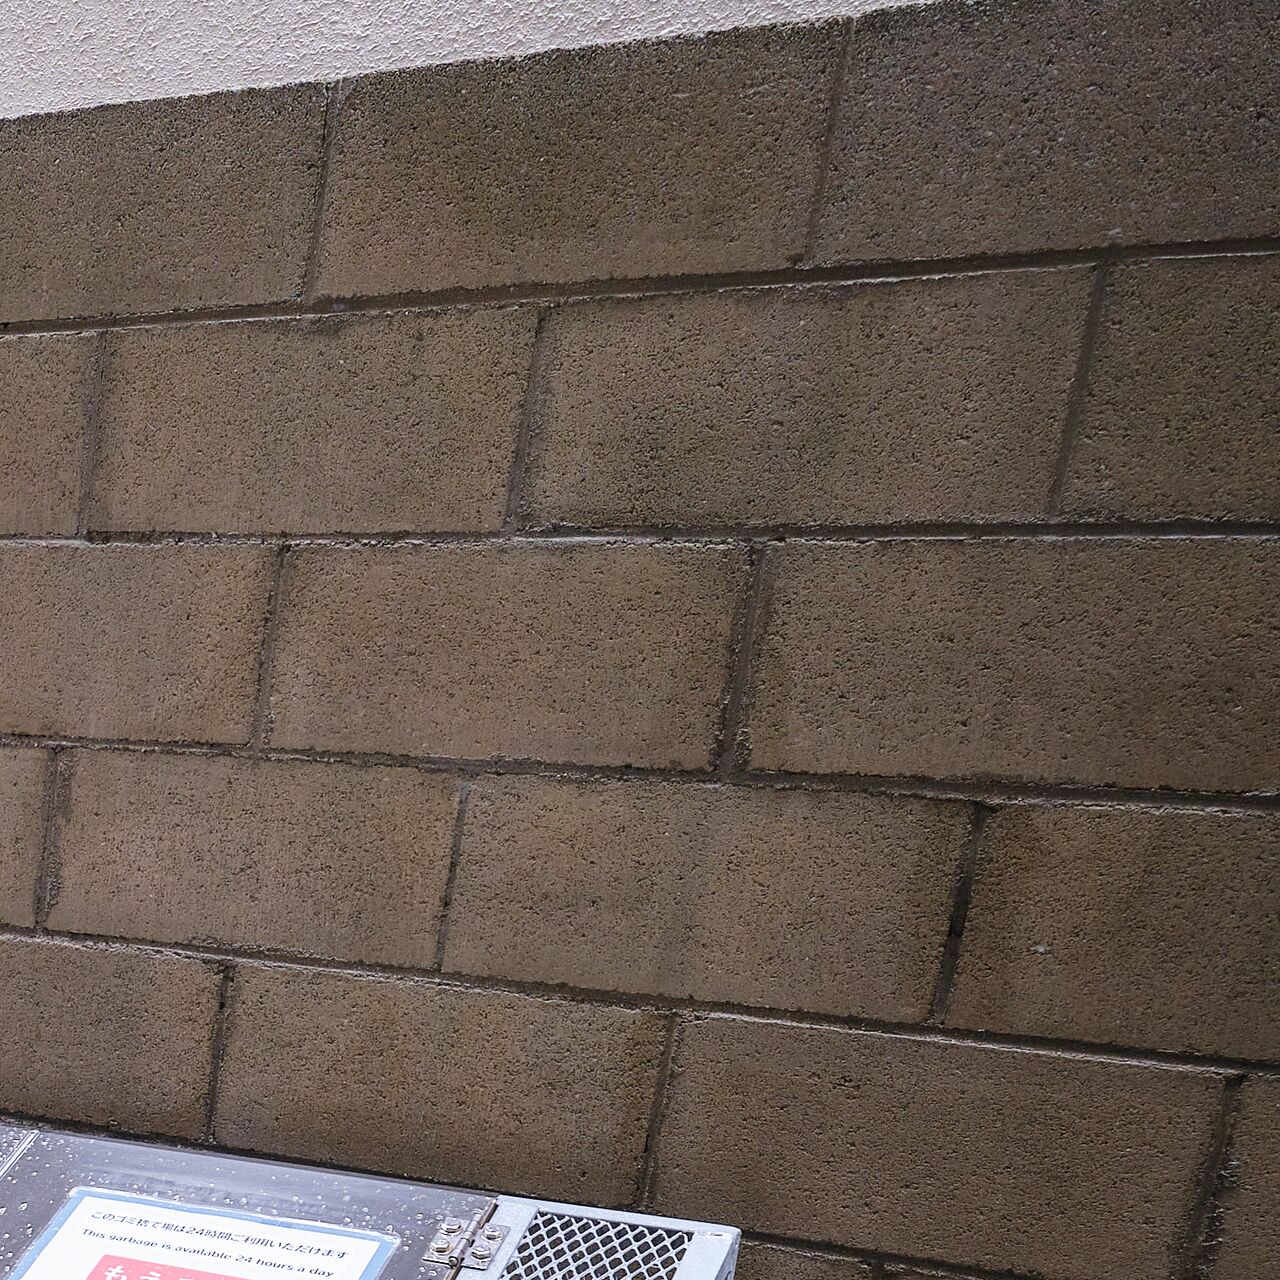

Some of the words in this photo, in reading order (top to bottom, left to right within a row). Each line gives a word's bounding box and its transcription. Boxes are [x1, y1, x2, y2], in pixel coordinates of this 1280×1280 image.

[82, 1227, 106, 1240] This
[109, 1233, 158, 1250] garbage
[161, 1241, 172, 1251] is
[174, 1244, 232, 1261] available
[234, 1253, 253, 1264] 24
[255, 1257, 294, 1272] hours
[308, 1266, 336, 1280] day
